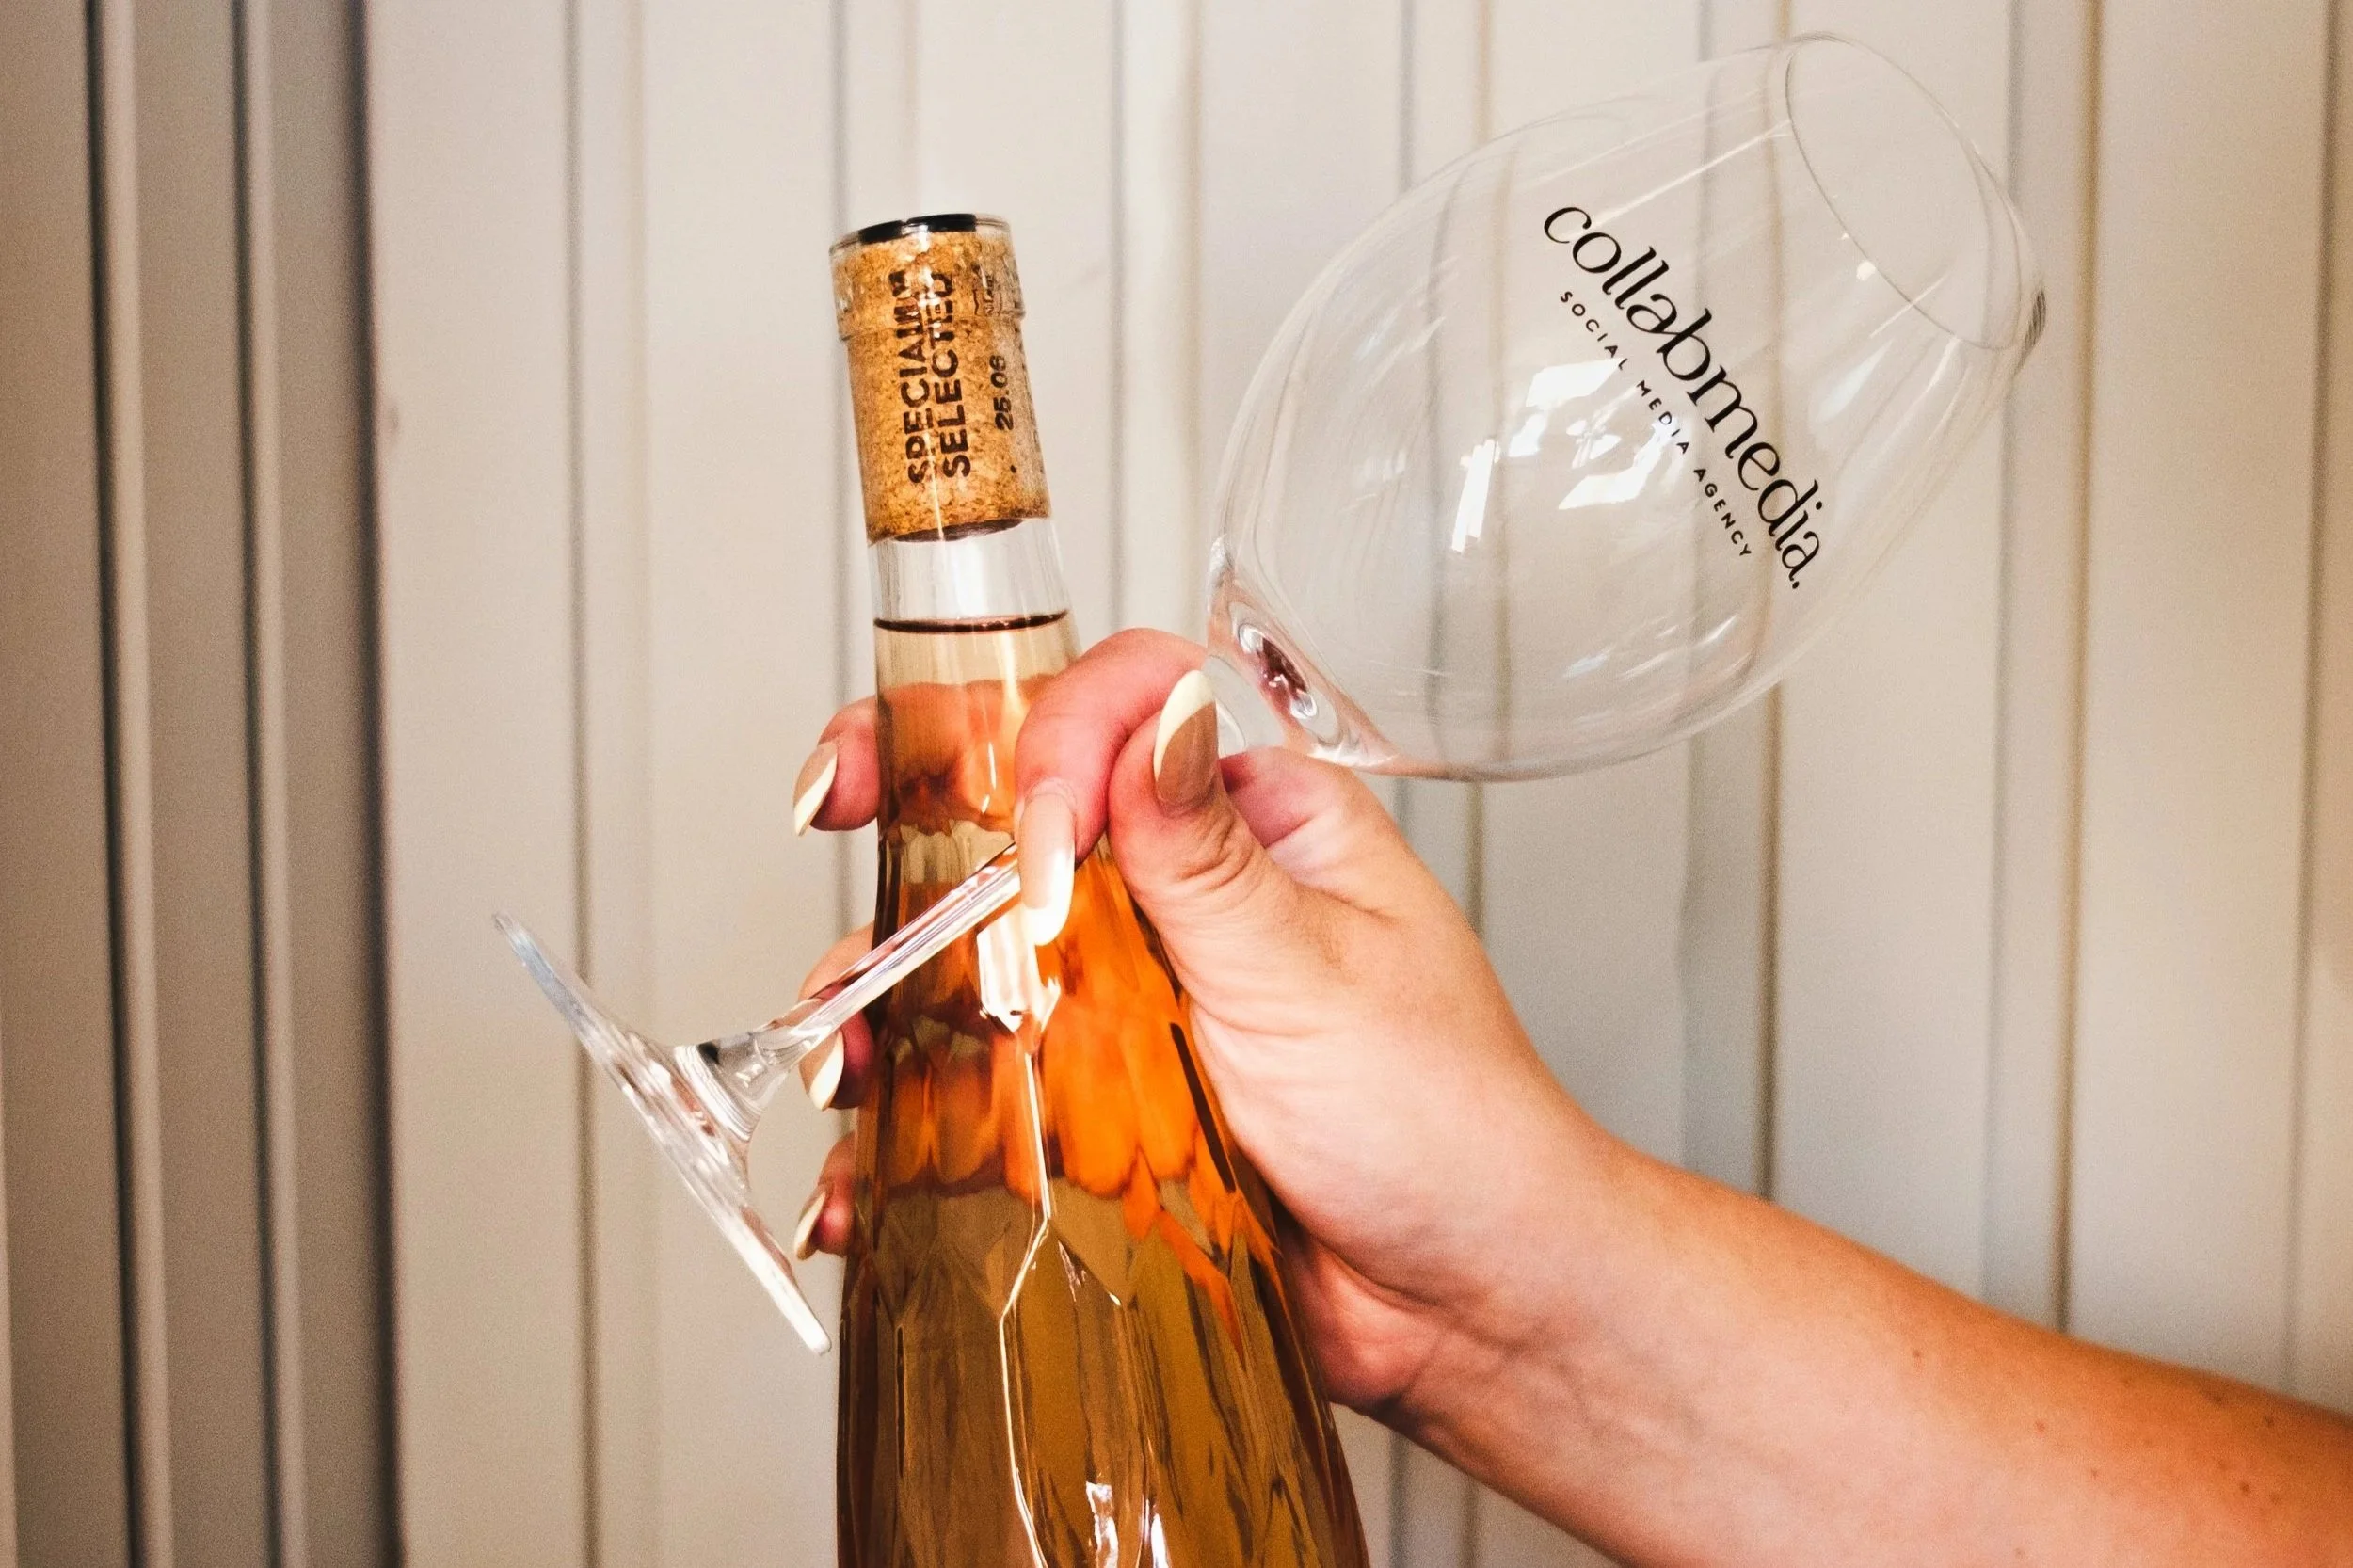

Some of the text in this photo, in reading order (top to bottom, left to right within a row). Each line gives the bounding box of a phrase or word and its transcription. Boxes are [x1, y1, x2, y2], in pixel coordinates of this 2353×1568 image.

[926, 271, 972, 480] SELECTED
[1544, 206, 1823, 590] collabmedia.
[1560, 290, 1752, 558] SOCIAL MEDIA AGENCY
